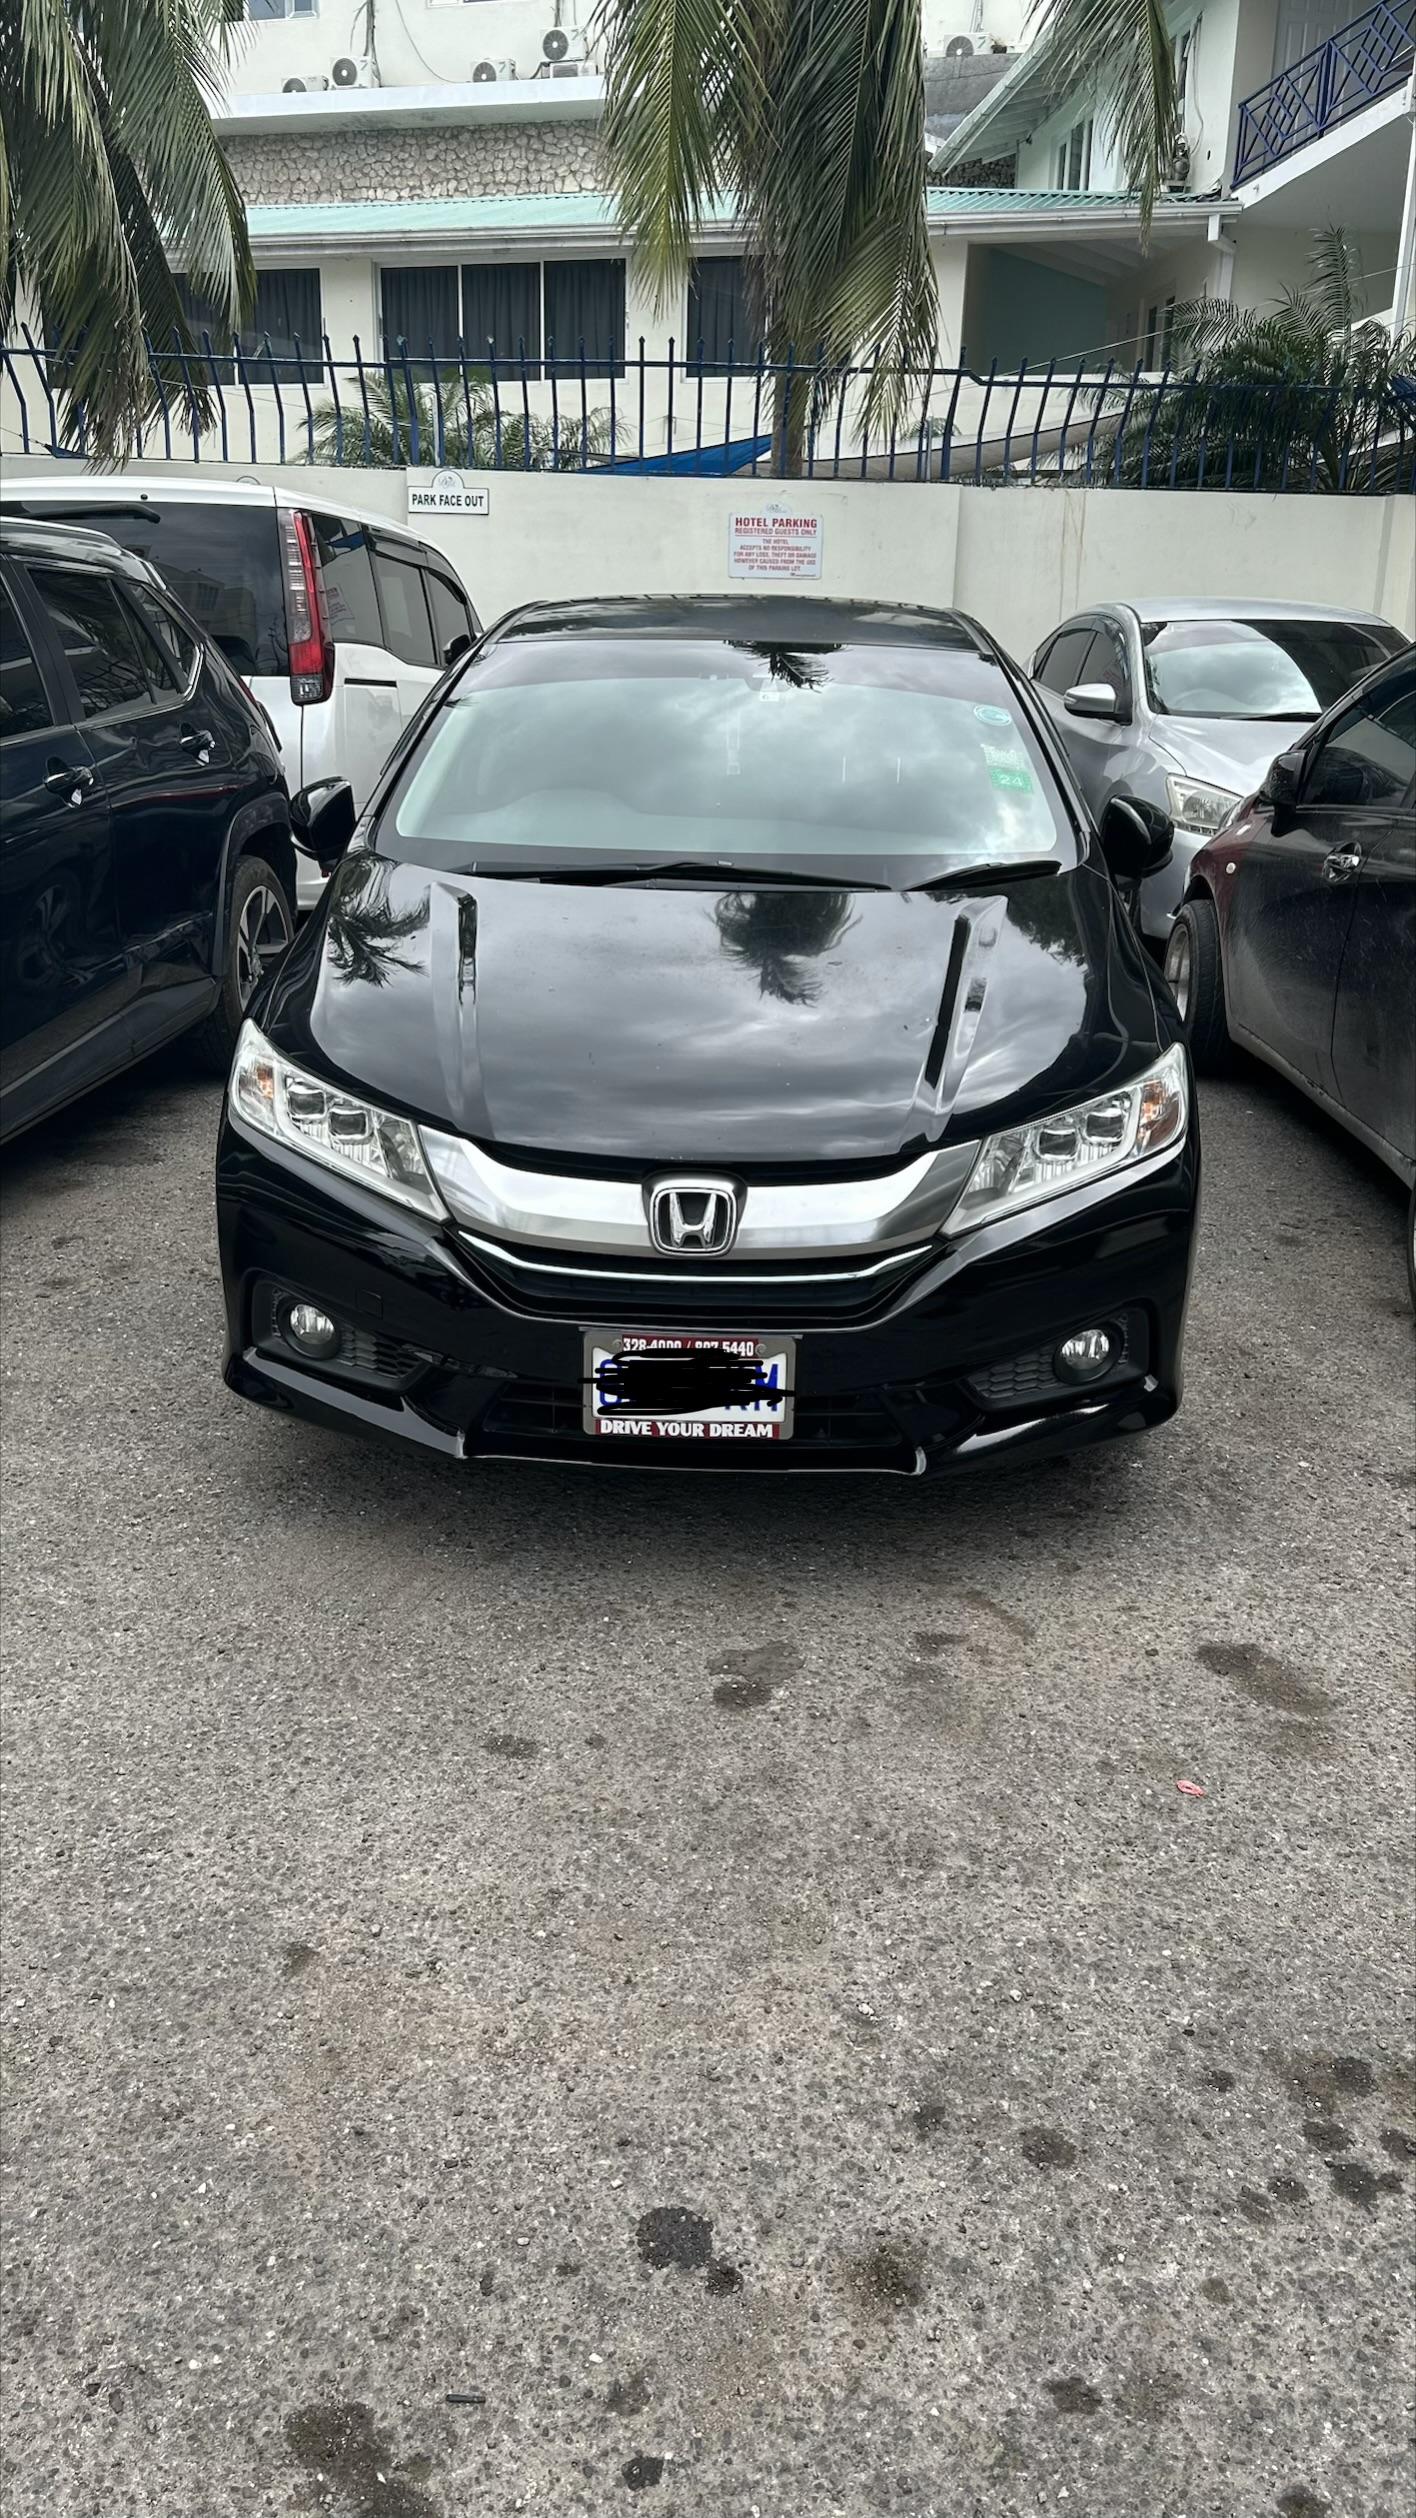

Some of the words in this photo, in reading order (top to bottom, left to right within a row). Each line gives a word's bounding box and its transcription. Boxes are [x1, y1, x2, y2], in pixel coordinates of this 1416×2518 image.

[412, 494, 437, 506] PARK
[440, 495, 462, 506] FACE
[465, 496, 484, 507] OUT
[735, 517, 768, 527] HOTEL
[772, 518, 817, 528] PARKING
[600, 1420, 652, 1435] DRIVE
[656, 1422, 704, 1437] YOUR
[709, 1424, 773, 1438] DREAM
